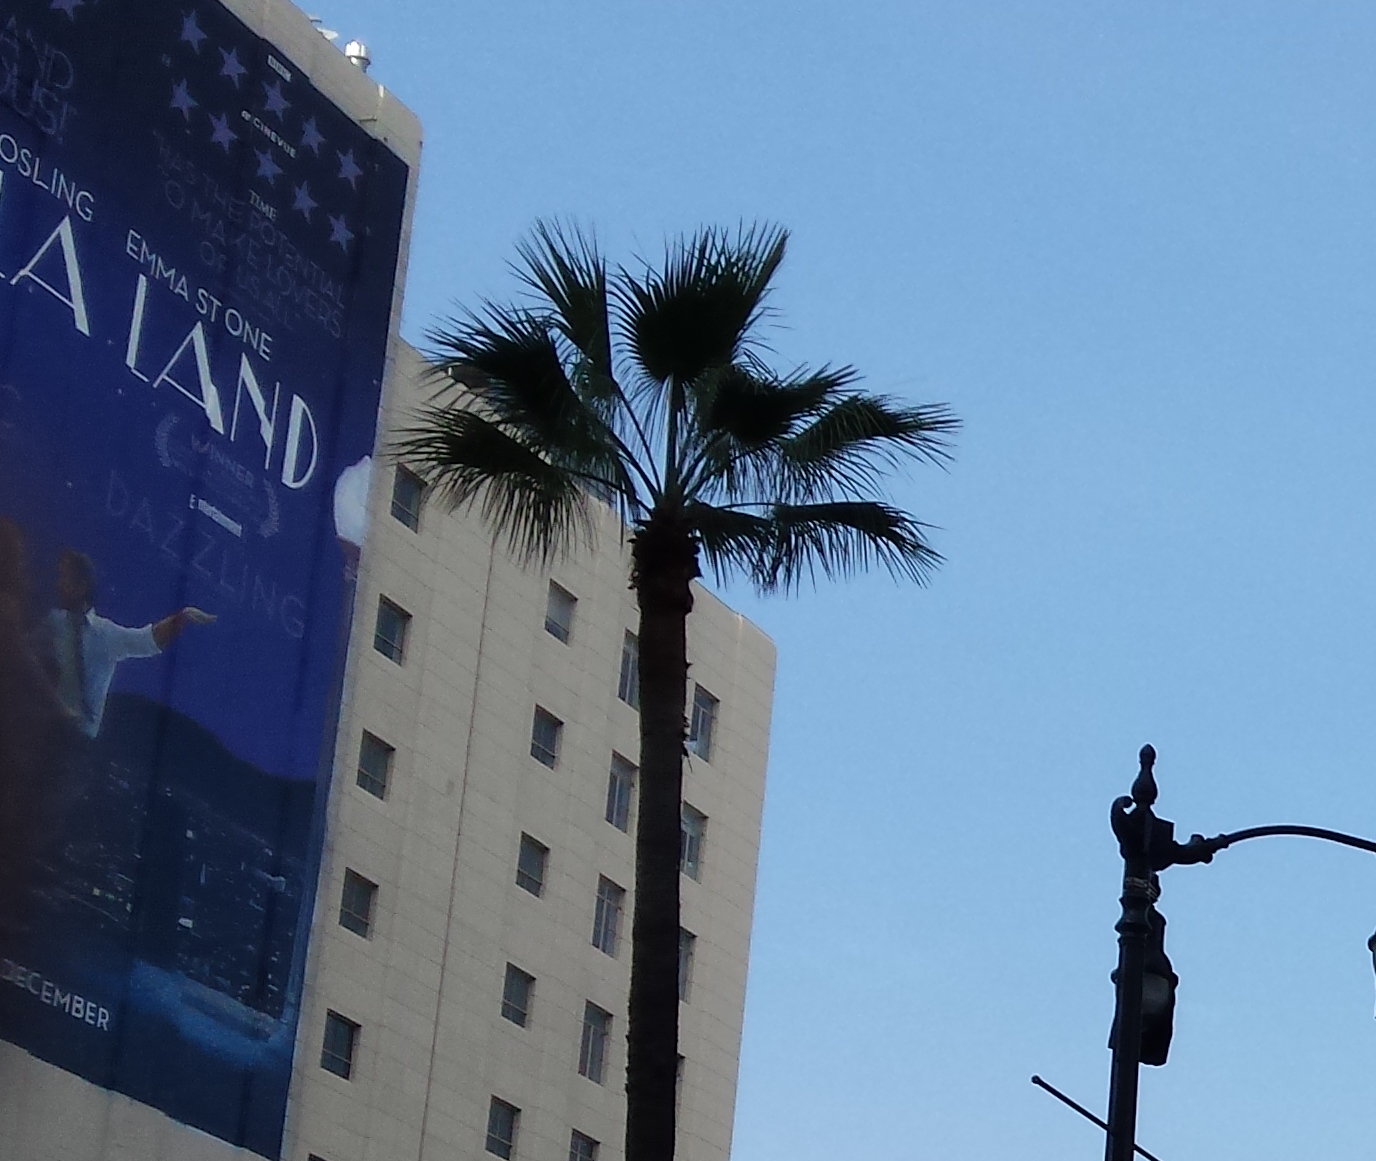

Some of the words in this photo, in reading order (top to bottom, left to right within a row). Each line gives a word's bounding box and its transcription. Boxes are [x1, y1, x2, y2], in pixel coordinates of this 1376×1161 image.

[0, 133, 95, 222] OSLING
[249, 189, 277, 222] TIME
[126, 229, 189, 302] EMMA
[195, 287, 273, 362] STONE
[125, 273, 318, 489] LAND
